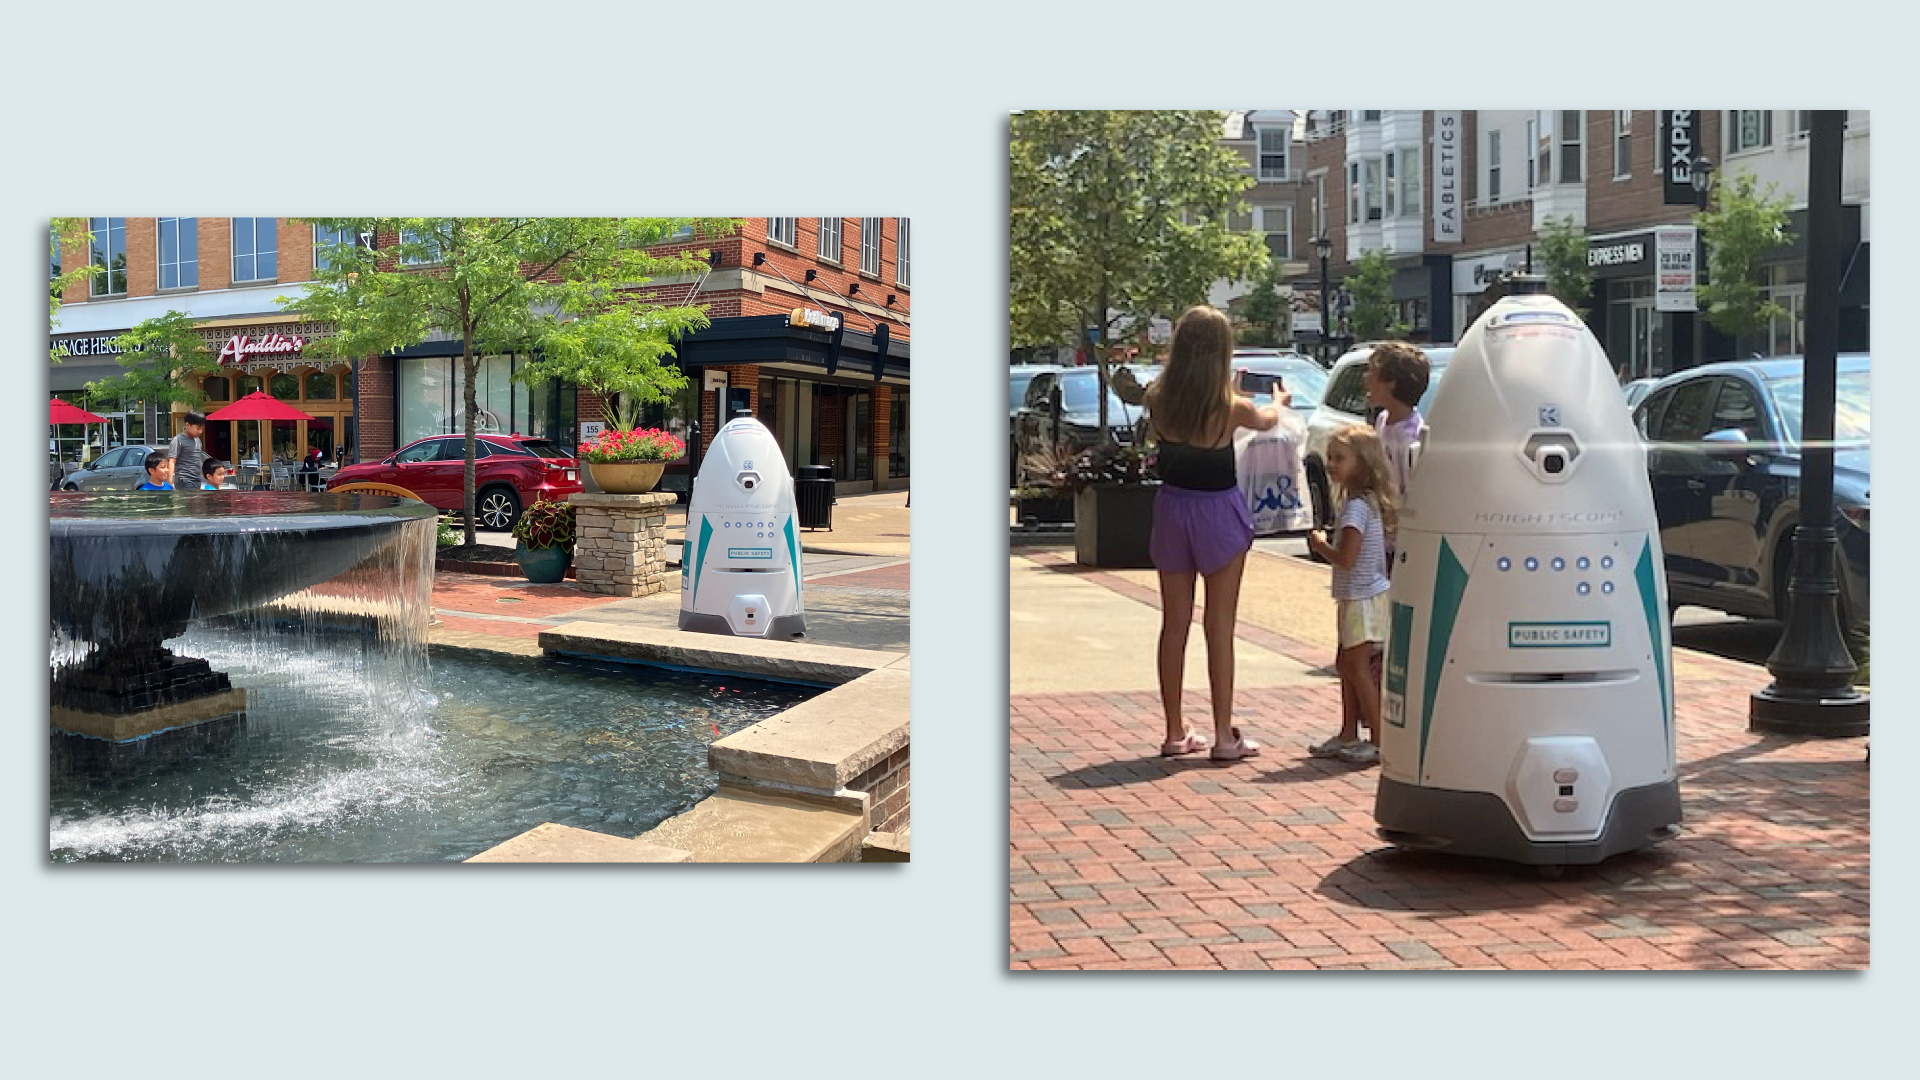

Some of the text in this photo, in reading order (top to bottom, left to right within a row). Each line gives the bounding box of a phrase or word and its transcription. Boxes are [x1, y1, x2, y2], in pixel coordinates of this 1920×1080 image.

[1441, 117, 1455, 234] FABLETICS
[1587, 243, 1645, 267] EXPRESS MEN
[216, 333, 305, 364] Aladdin's
[586, 425, 599, 434] 155
[1514, 629, 1606, 641] PUBLIC SAFETY
